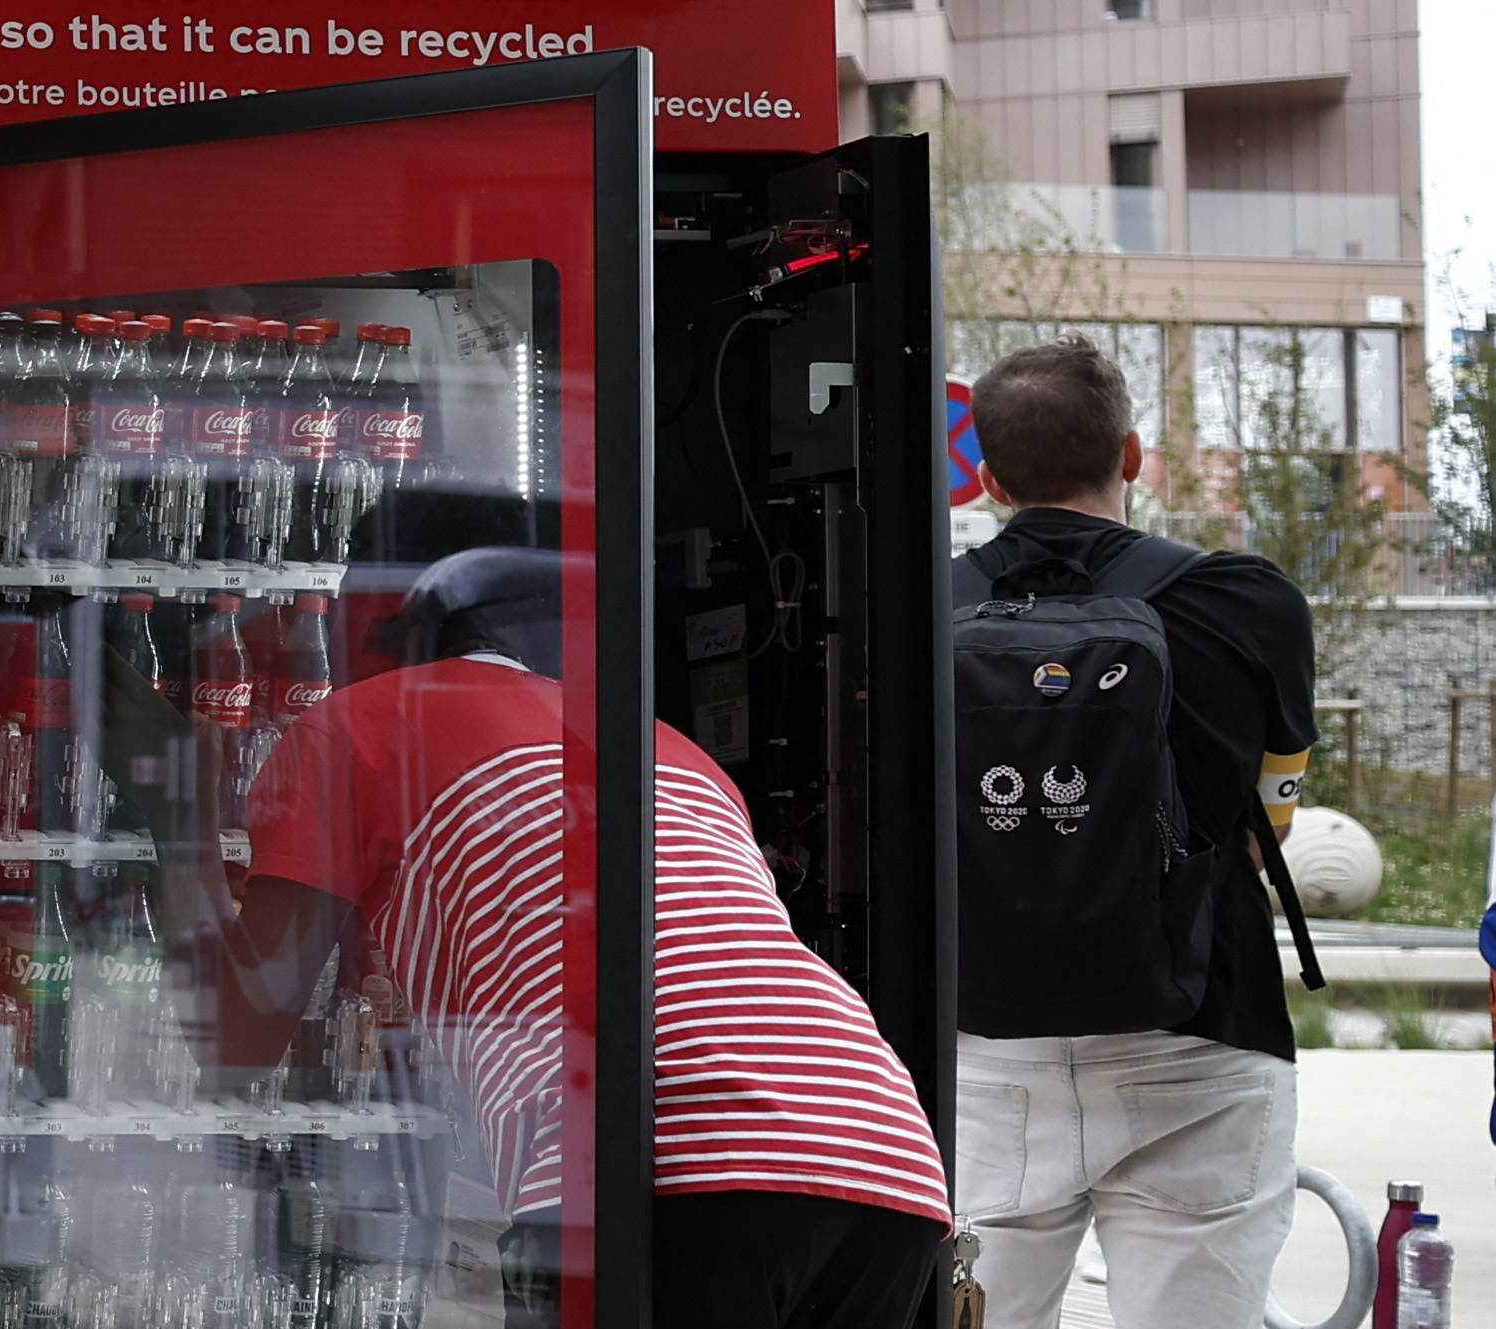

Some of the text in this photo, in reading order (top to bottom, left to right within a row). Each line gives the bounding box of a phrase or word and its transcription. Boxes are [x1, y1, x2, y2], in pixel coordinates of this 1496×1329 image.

[0, 21, 54, 49] so
[68, 14, 167, 52] that
[183, 15, 214, 53] it
[229, 26, 310, 55] can
[327, 19, 384, 56] be
[655, 88, 801, 122] recyclée.
[135, 575, 152, 585] 104
[979, 805, 1028, 816] TOKYO 2020
[1040, 804, 1090, 815] TOKYO 2020
